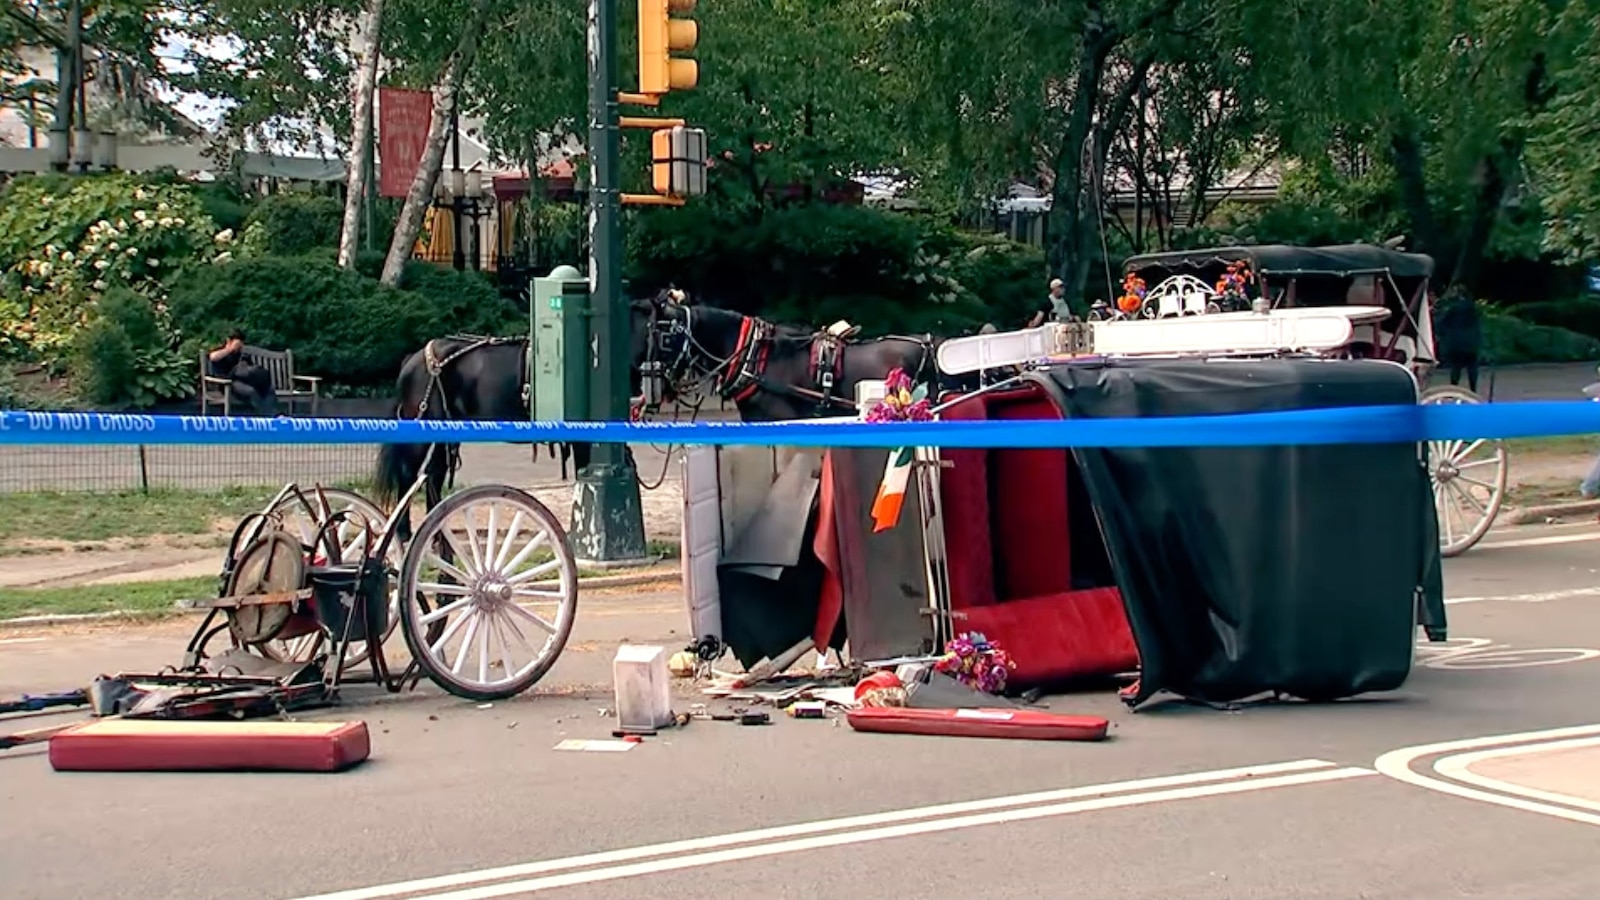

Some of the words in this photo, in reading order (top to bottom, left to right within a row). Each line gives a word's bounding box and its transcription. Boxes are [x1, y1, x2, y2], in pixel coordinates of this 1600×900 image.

[27, 411, 53, 431] DO
[58, 412, 91, 431] NOT
[97, 413, 156, 432] CROSS
[180, 416, 239, 432] POLICE
